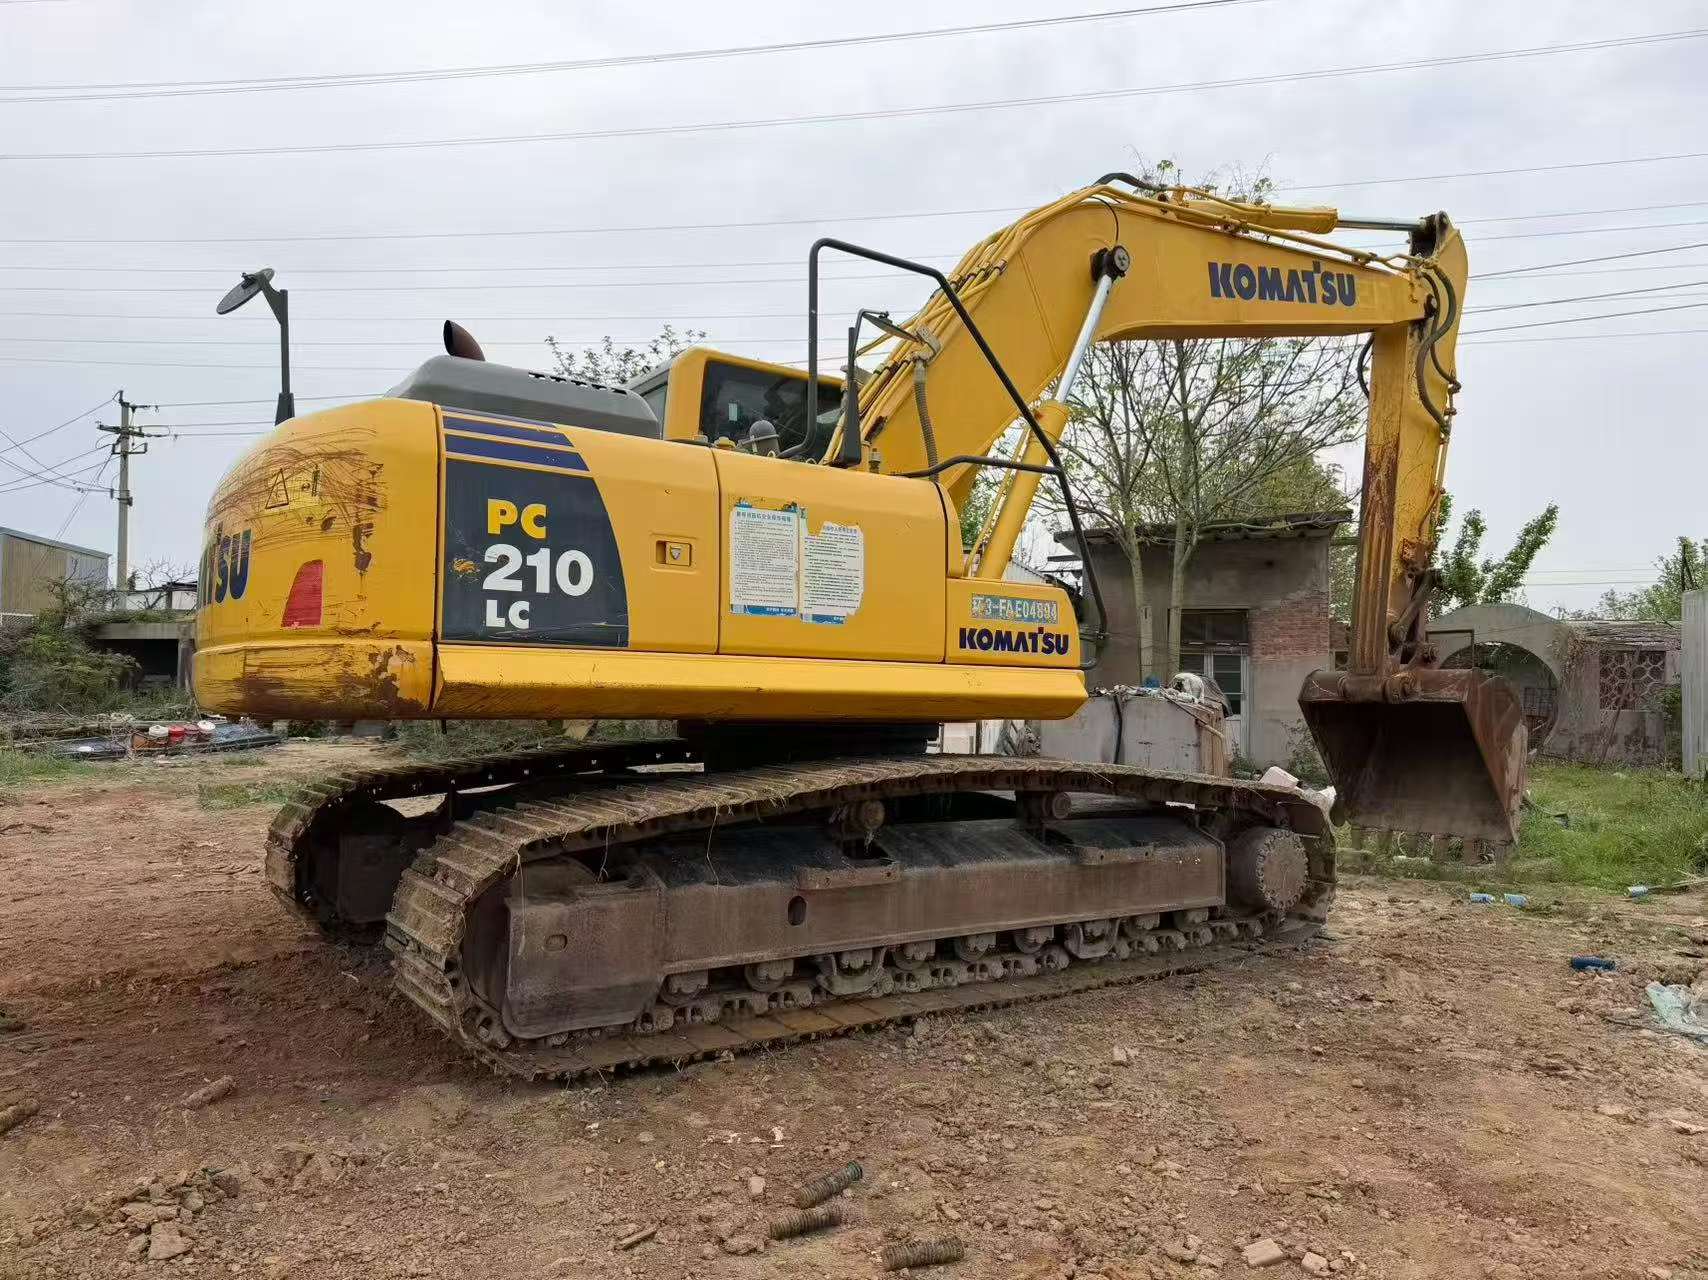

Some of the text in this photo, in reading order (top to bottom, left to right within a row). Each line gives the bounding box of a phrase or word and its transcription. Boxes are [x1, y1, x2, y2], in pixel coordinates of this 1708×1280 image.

[1208, 260, 1357, 307] KOMATSU
[487, 498, 549, 539] PC
[482, 543, 594, 596] 210
[485, 599, 530, 629] LC
[958, 626, 1070, 655] KOMATSU
